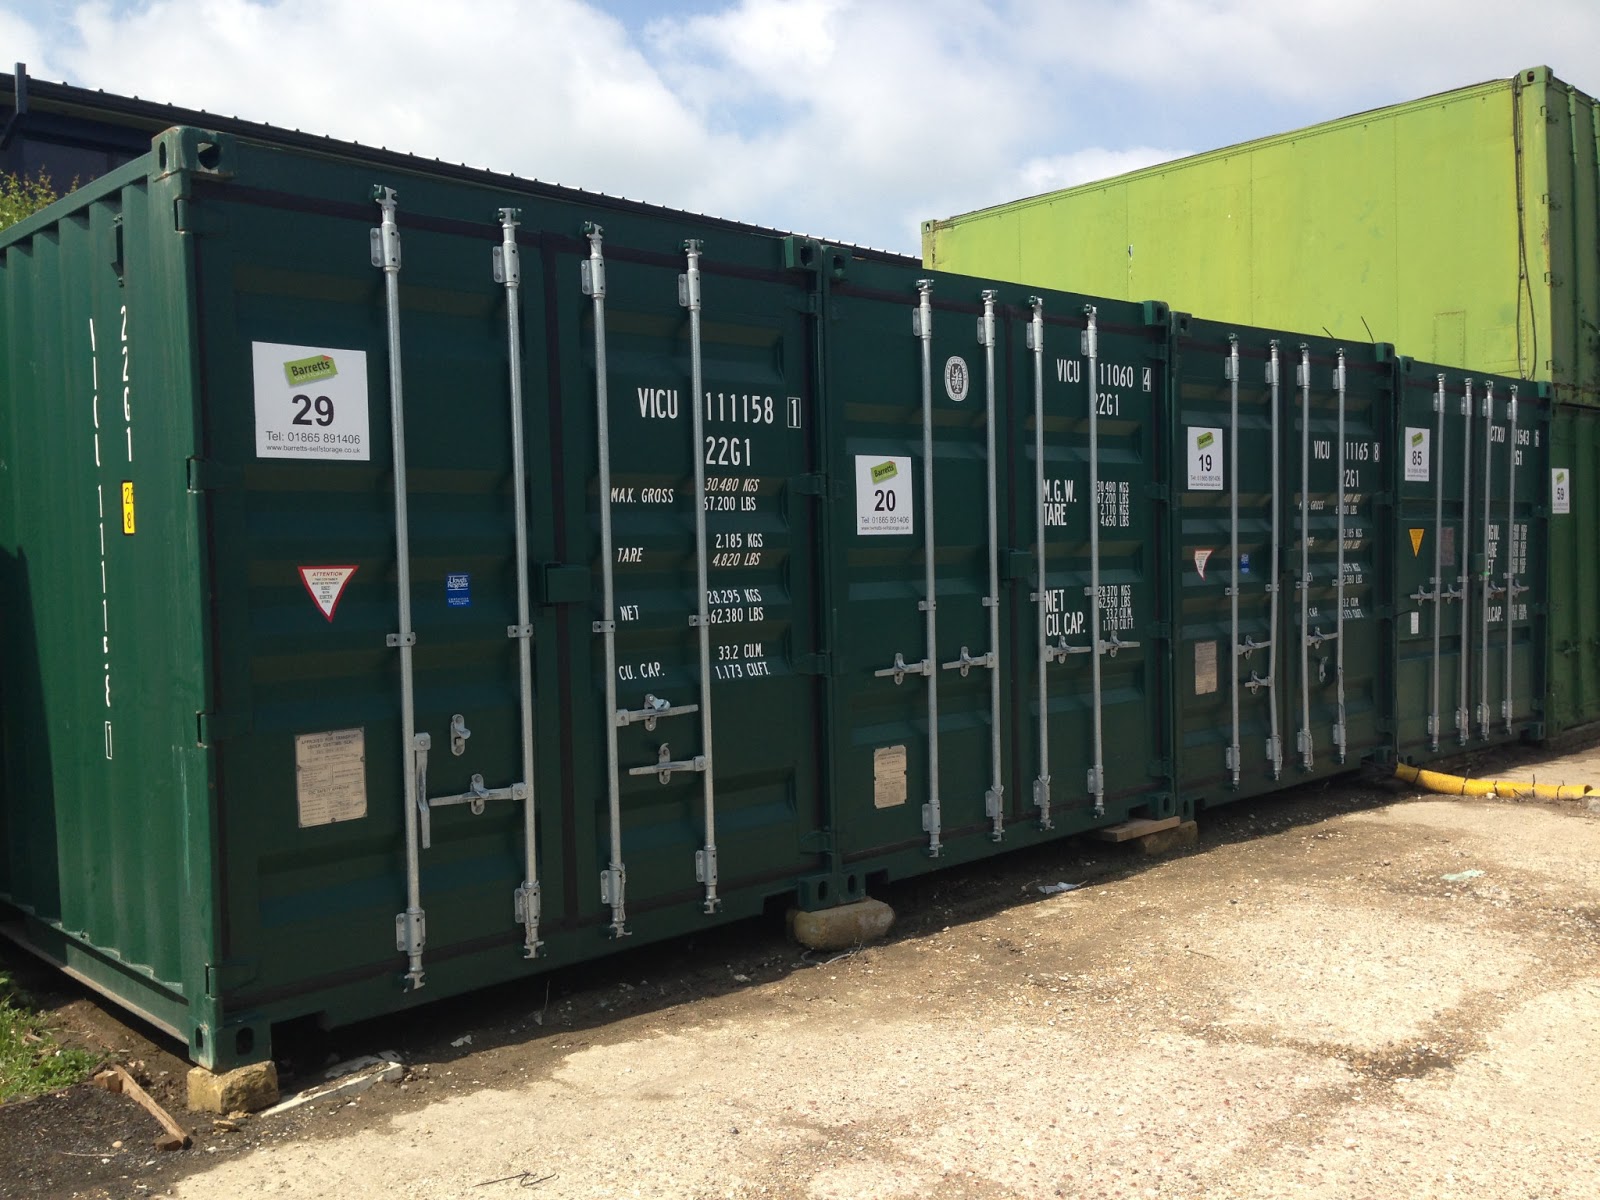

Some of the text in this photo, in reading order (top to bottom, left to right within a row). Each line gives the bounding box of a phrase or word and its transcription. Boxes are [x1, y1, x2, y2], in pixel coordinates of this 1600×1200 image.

[291, 361, 330, 376] Barretts
[1056, 358, 1150, 391] VICU 11060 4
[291, 394, 335, 427] 29
[637, 387, 678, 419] VICU
[705, 392, 774, 424] 111158
[265, 431, 360, 444] Tel: 01865 891406
[705, 435, 751, 467] 22G1
[1314, 440, 1380, 462] VICU 11165 8
[1412, 450, 1422, 466] 85
[874, 464, 894, 477] Barretts
[1198, 454, 1212, 472] 19
[704, 477, 760, 492] 30.480 KGS
[1119, 481, 1129, 493] KGS
[610, 487, 674, 503] MAX. GROSS
[874, 489, 896, 512] 20
[1119, 493, 1129, 504] LBS
[1557, 487, 1565, 500] 59
[741, 497, 757, 511] LBS
[1119, 504, 1129, 515] KGS
[1044, 503, 1068, 526] TARE
[1119, 515, 1129, 527] LBS
[715, 533, 763, 549] 2.185 KGS
[617, 548, 644, 563] TARE
[712, 552, 761, 567] 4.820 LBS
[744, 588, 762, 602] KGS
[1045, 589, 1065, 613] NET
[1120, 596, 1131, 608] LBS
[619, 605, 639, 621] NET
[710, 606, 764, 624] 62.380 LBS
[1046, 612, 1086, 636] CU. CAP.
[718, 644, 739, 661] 33.2
[618, 661, 666, 681] CU. CAP.
